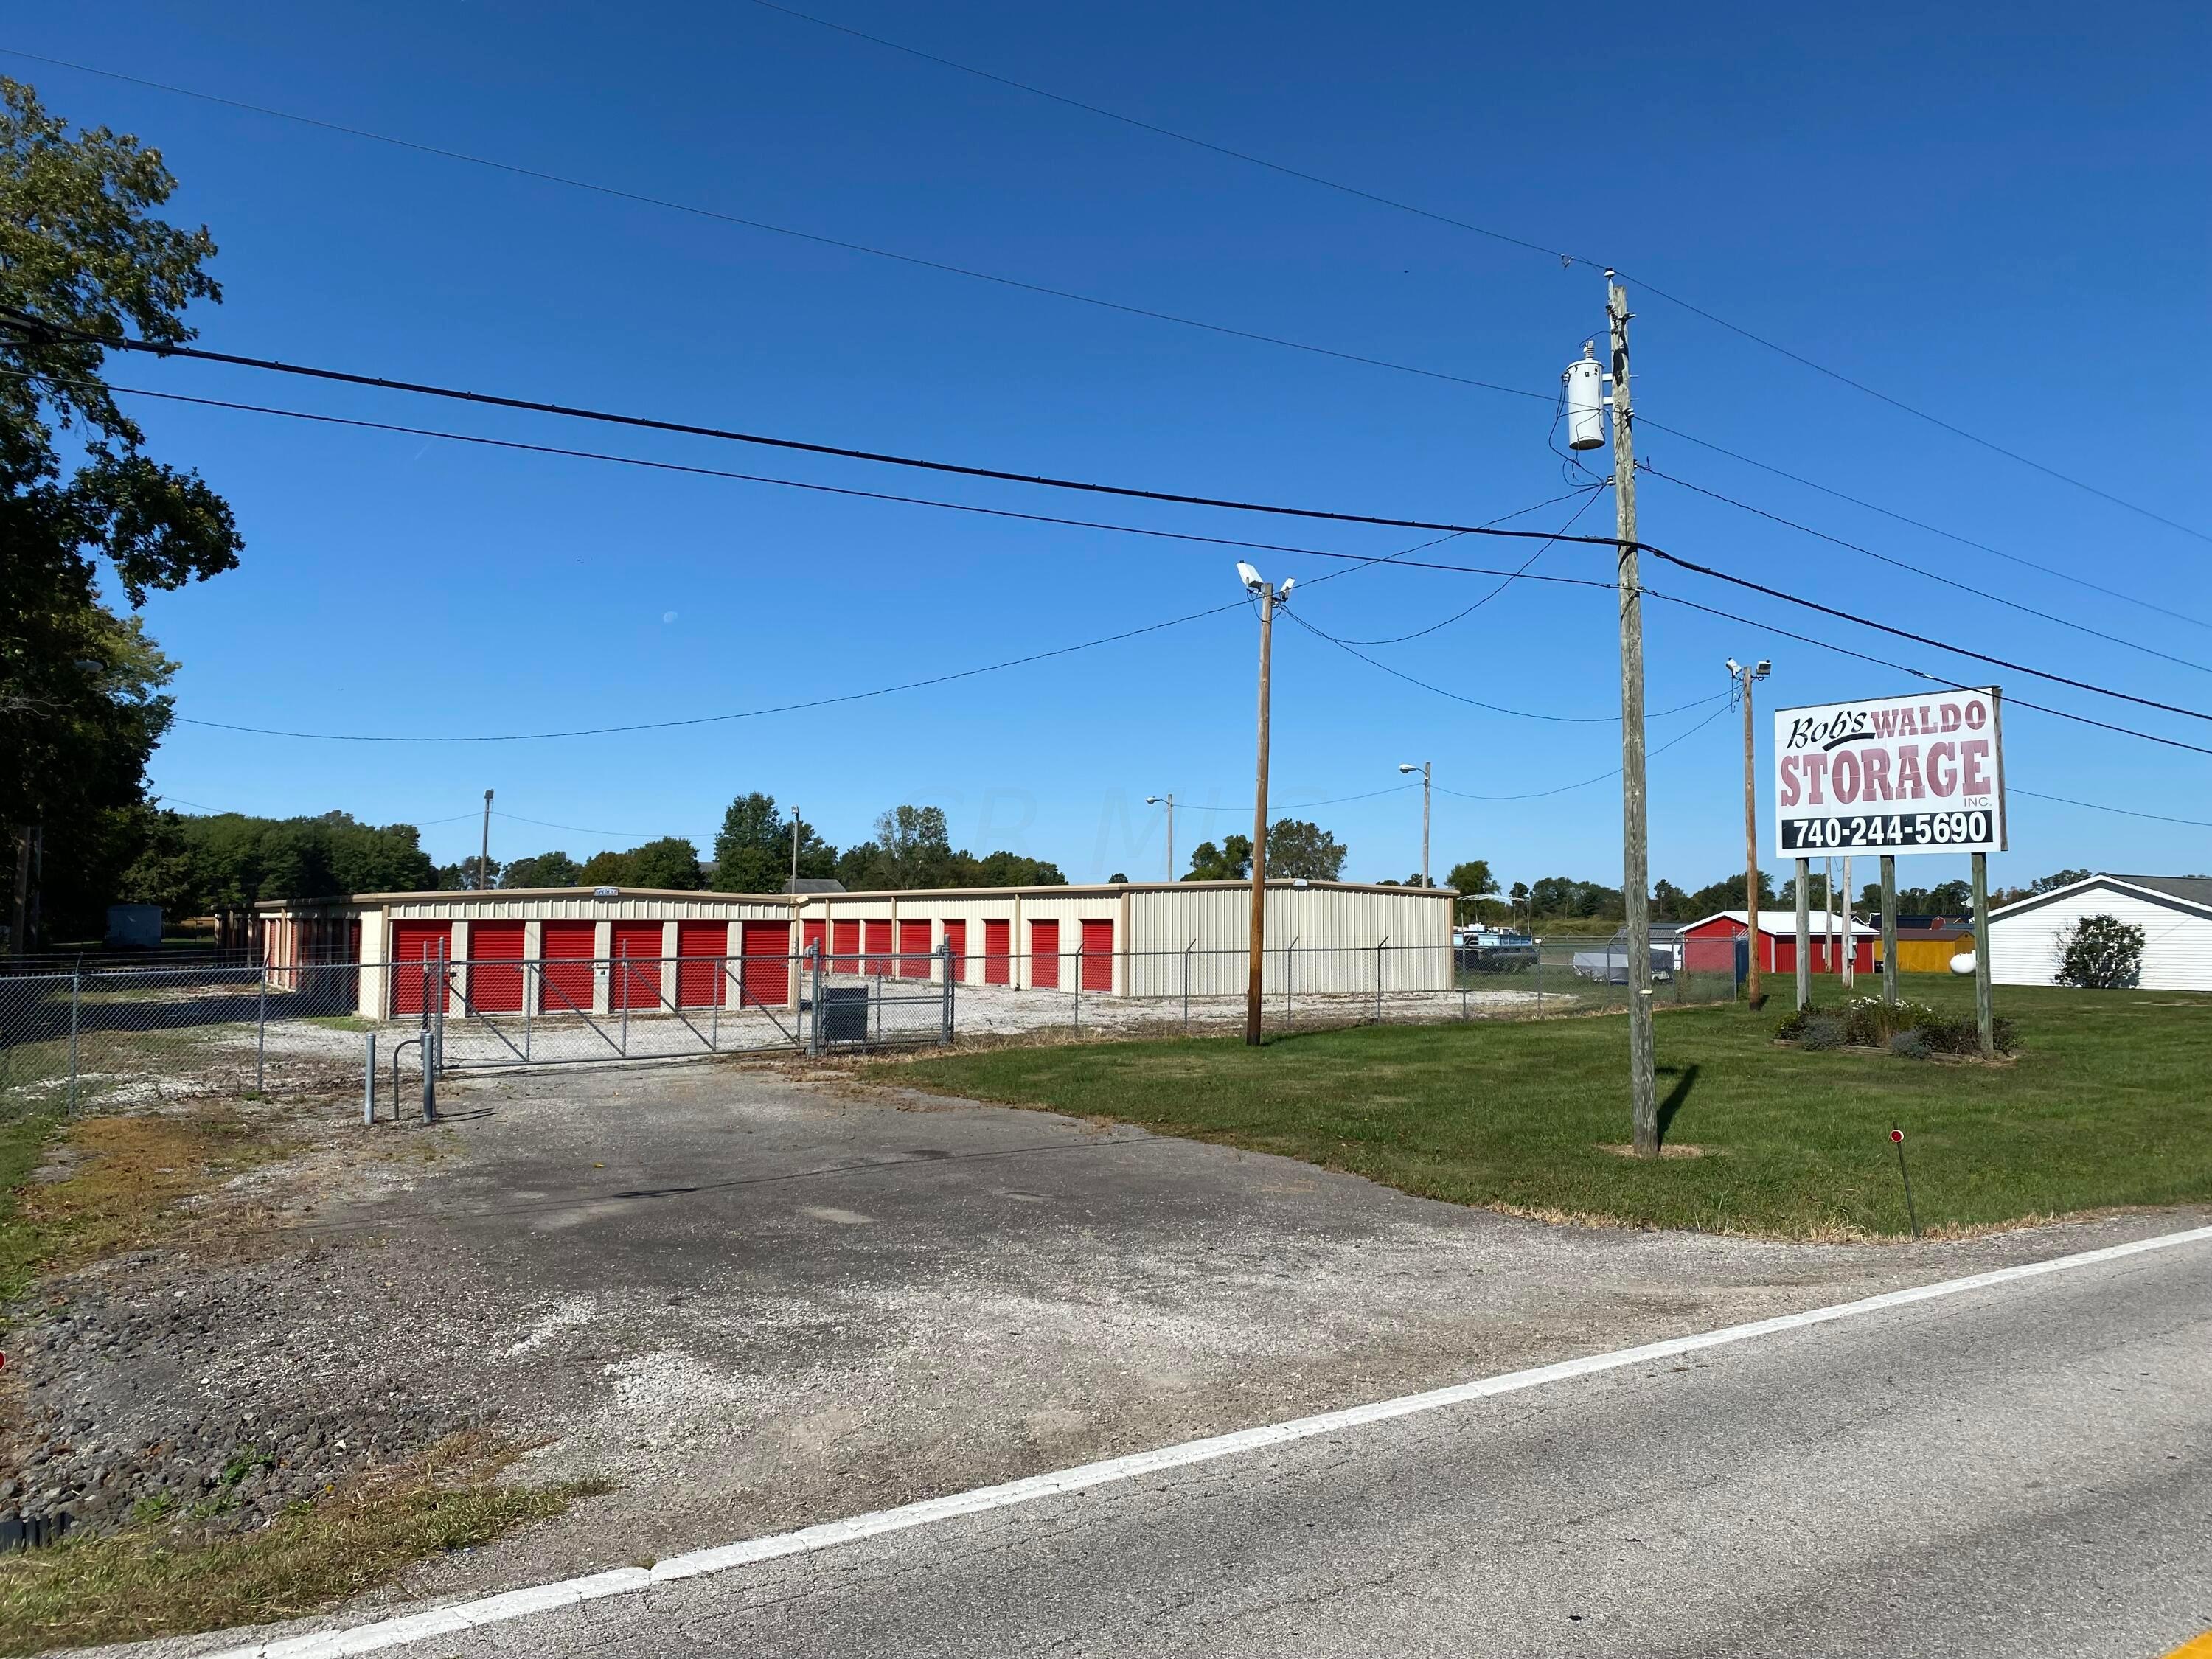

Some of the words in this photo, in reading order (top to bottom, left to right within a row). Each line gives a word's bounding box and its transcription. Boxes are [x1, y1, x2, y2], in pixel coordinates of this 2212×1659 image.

[1787, 710, 1867, 749] Bob's
[1871, 700, 1986, 739] WALDO
[1781, 739, 1991, 807] STORAGE
[1964, 796, 1992, 807] INC.
[1793, 811, 1986, 847] 740-244-5690
